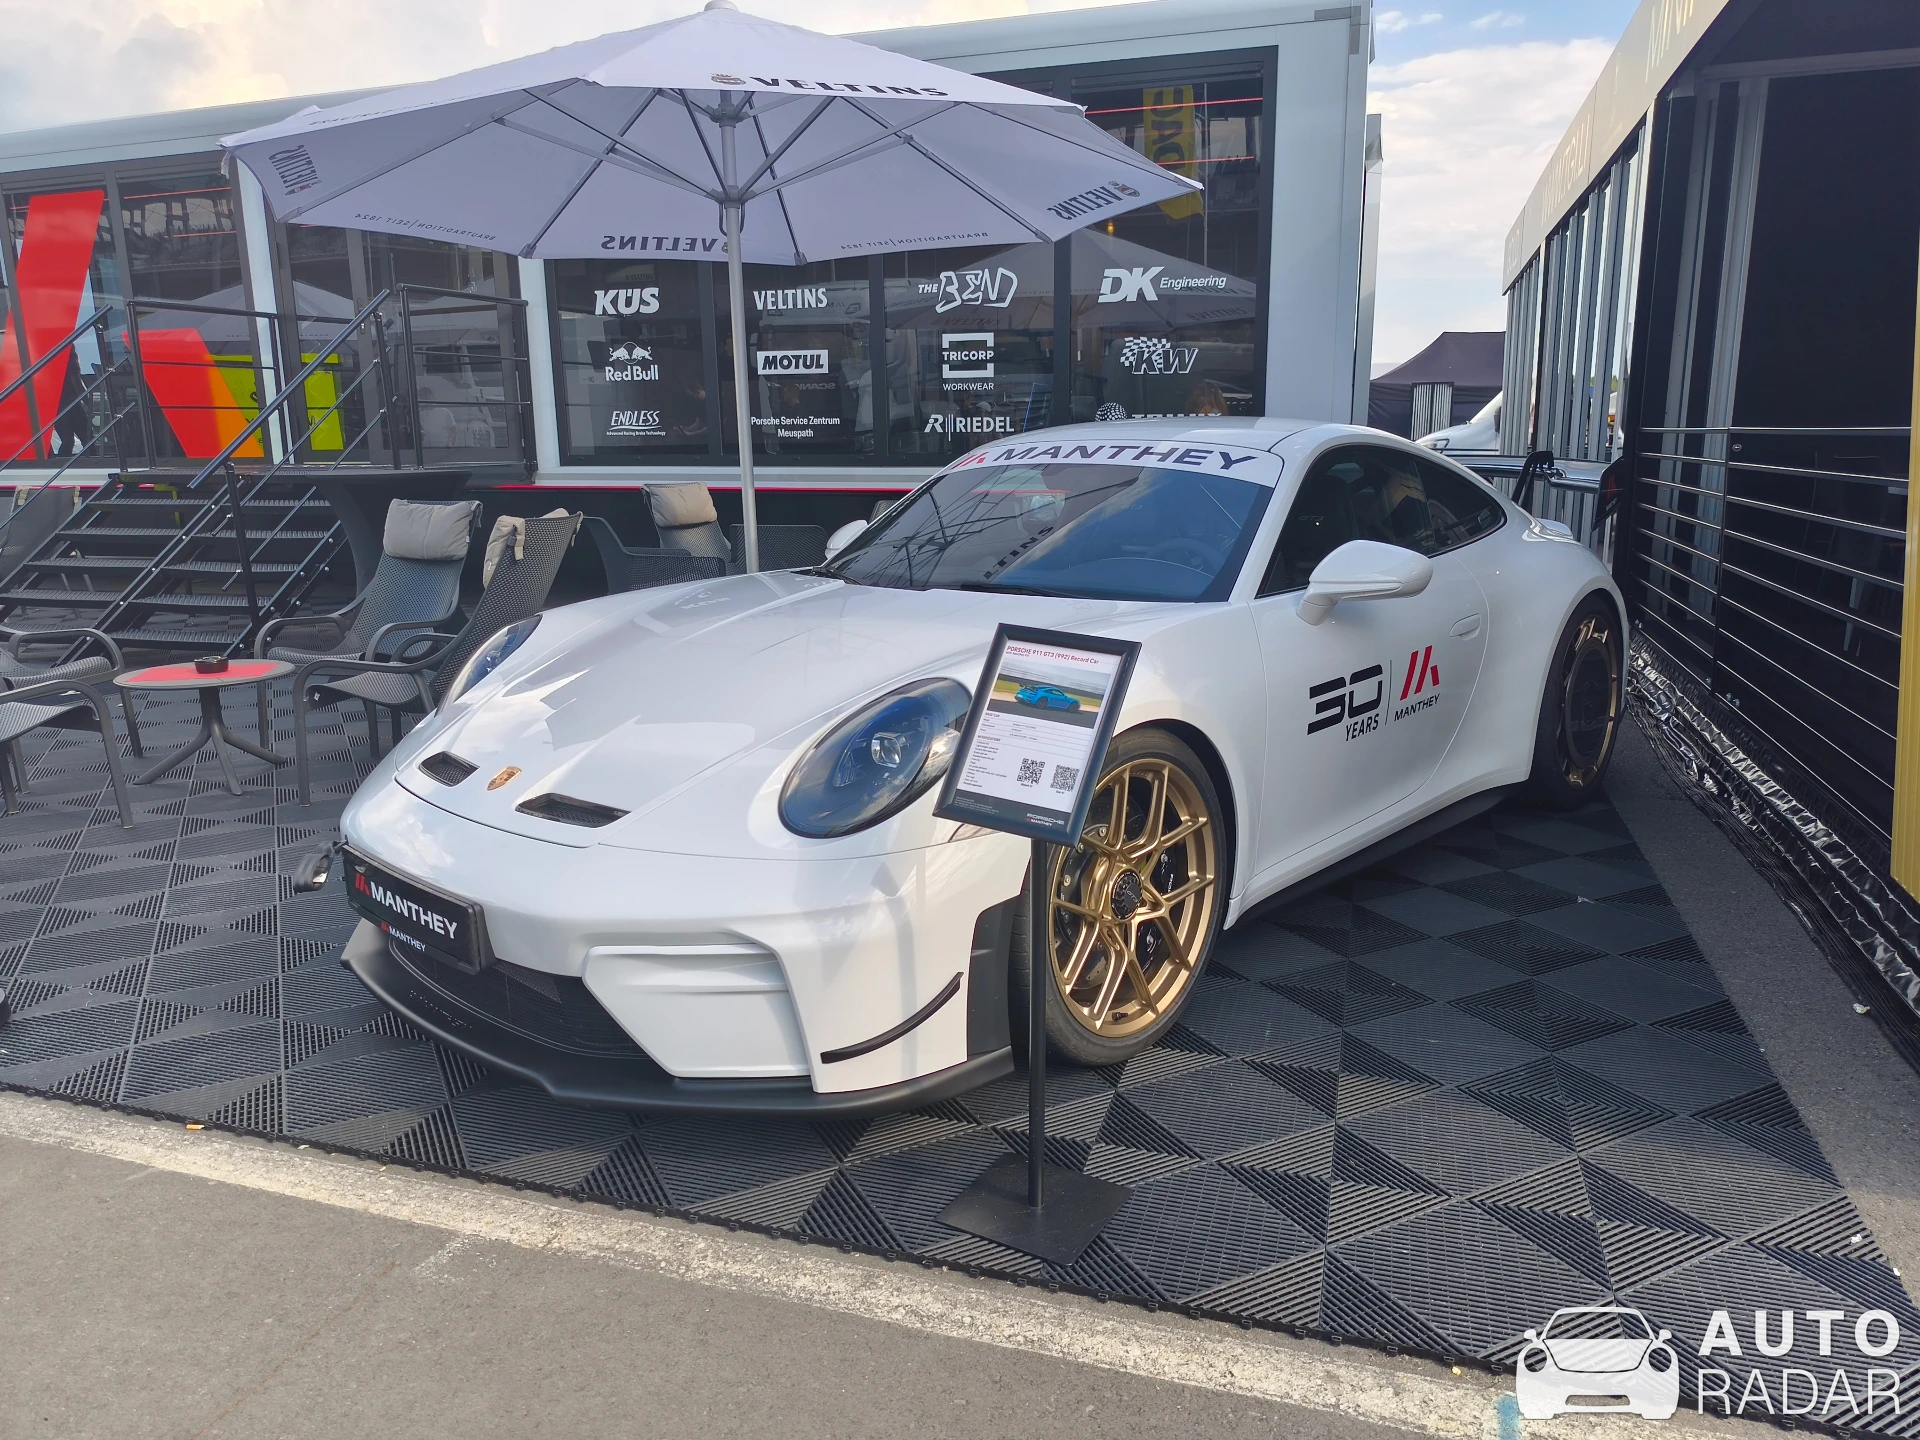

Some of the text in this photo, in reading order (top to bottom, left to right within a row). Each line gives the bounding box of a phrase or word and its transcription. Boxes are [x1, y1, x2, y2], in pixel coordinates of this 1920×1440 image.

[750, 76, 948, 96] VELTINS
[918, 267, 1018, 314] THE BEND
[1098, 266, 1227, 303] DK Engineering
[594, 286, 660, 315] KÜS
[753, 287, 828, 310] VELTINS
[762, 354, 824, 370] MOTUL
[942, 351, 994, 361] TRICORP
[1132, 347, 1199, 375] KW
[605, 365, 658, 381] Red Bull
[943, 383, 994, 391] WORKWEAR
[611, 410, 660, 426] ENDLESS
[751, 416, 840, 426] Porsche Service Zentrum
[956, 416, 1014, 433] RIEDEL
[778, 428, 814, 439] Meuspath
[993, 445, 1259, 471] MANTHEY
[1006, 646, 1032, 655] PORSCHE
[1055, 652, 1070, 660] (992)
[1070, 655, 1090, 663] Record
[1307, 664, 1383, 736] 30
[1394, 693, 1440, 722] MANTHEY
[1345, 713, 1379, 742] YEARS
[370, 881, 458, 940] MANTHEY
[389, 926, 426, 952] MANTHEY
